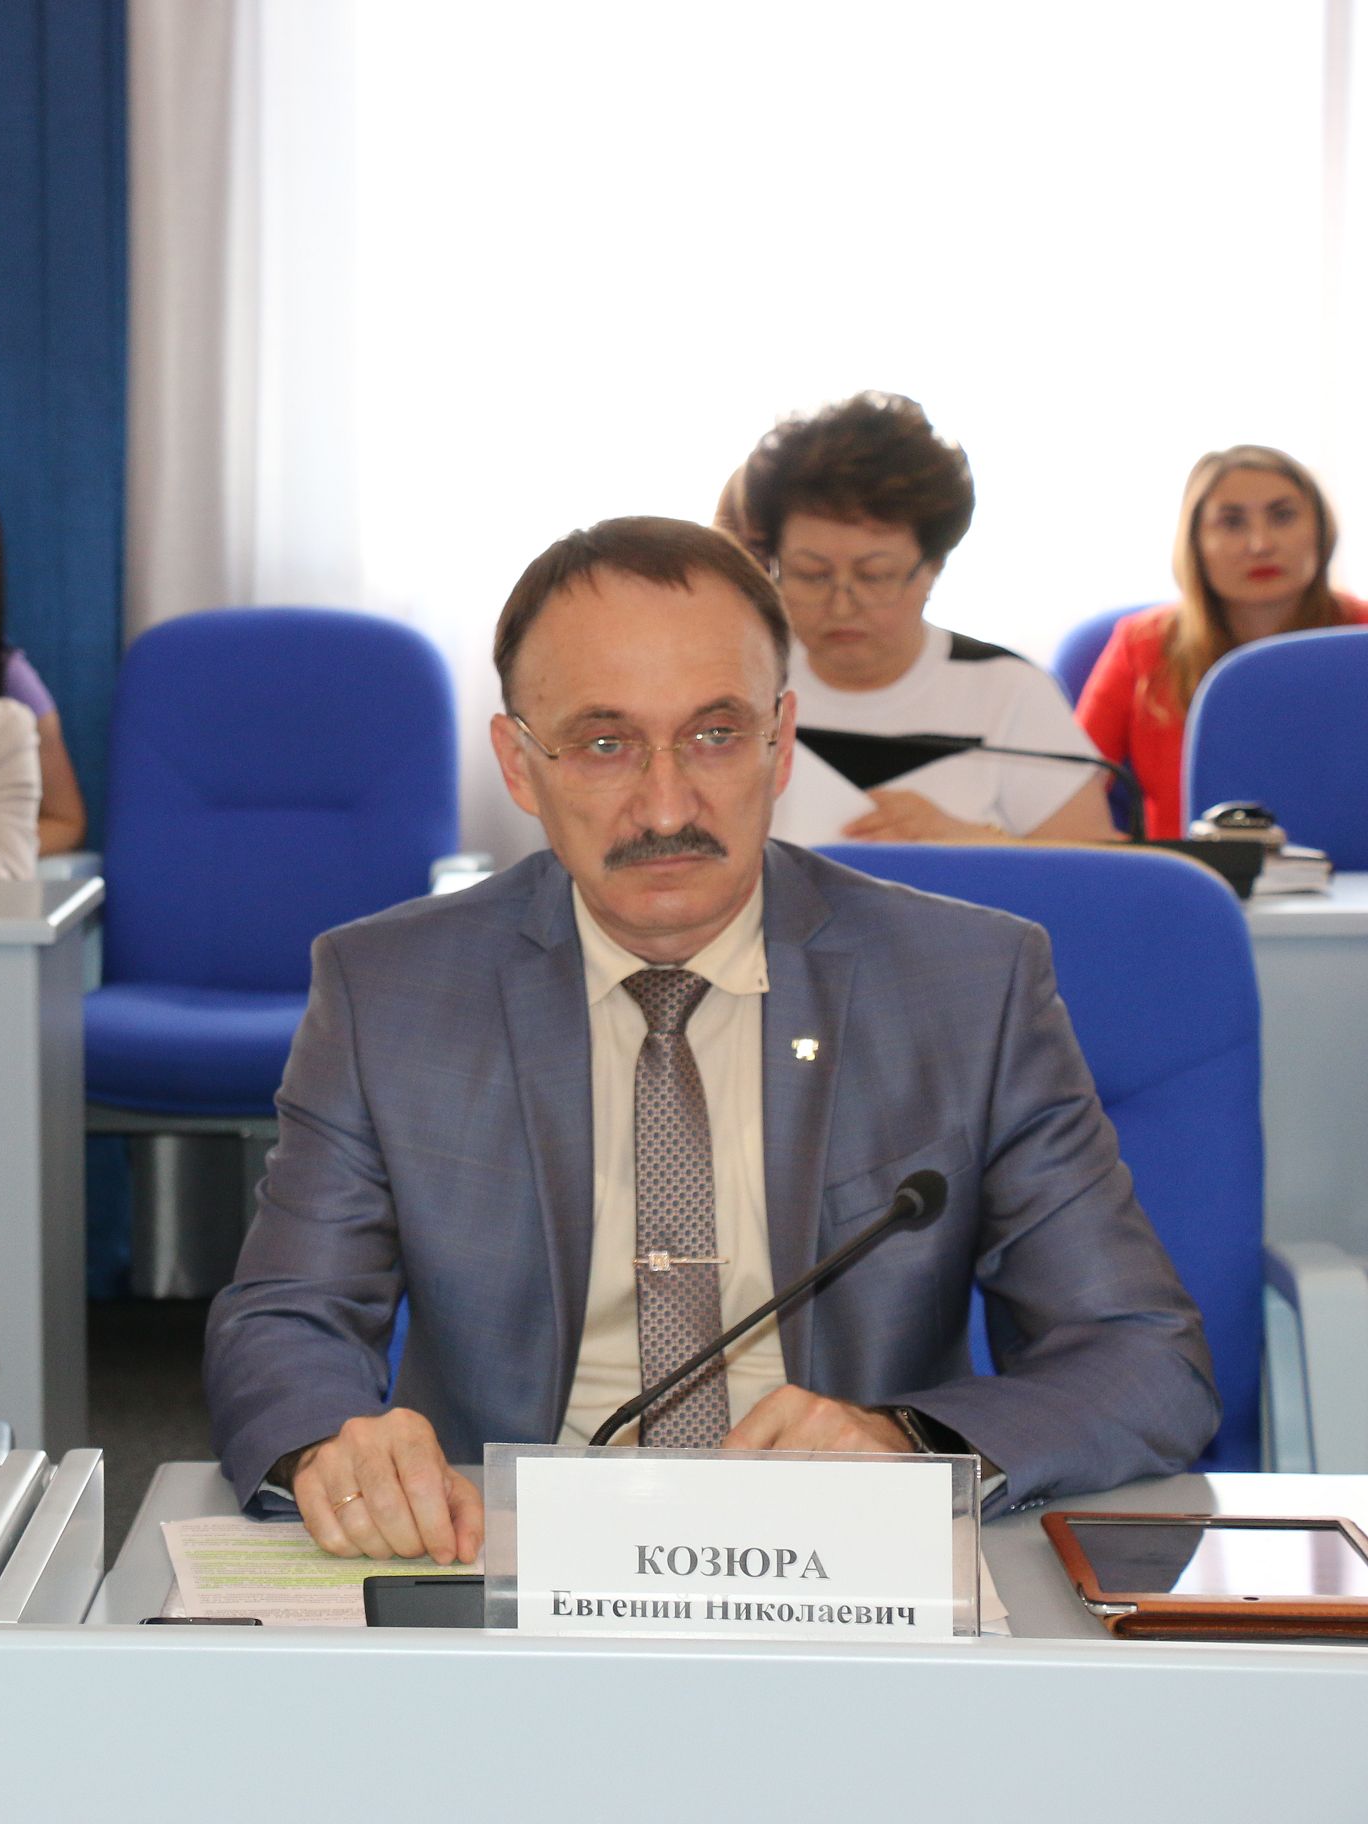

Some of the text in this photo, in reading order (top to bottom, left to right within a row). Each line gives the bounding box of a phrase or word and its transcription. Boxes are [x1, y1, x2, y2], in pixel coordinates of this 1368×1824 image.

[634, 1545, 830, 1579] КОЗЮРА
[550, 1589, 916, 1626] Евгений Николаевич
